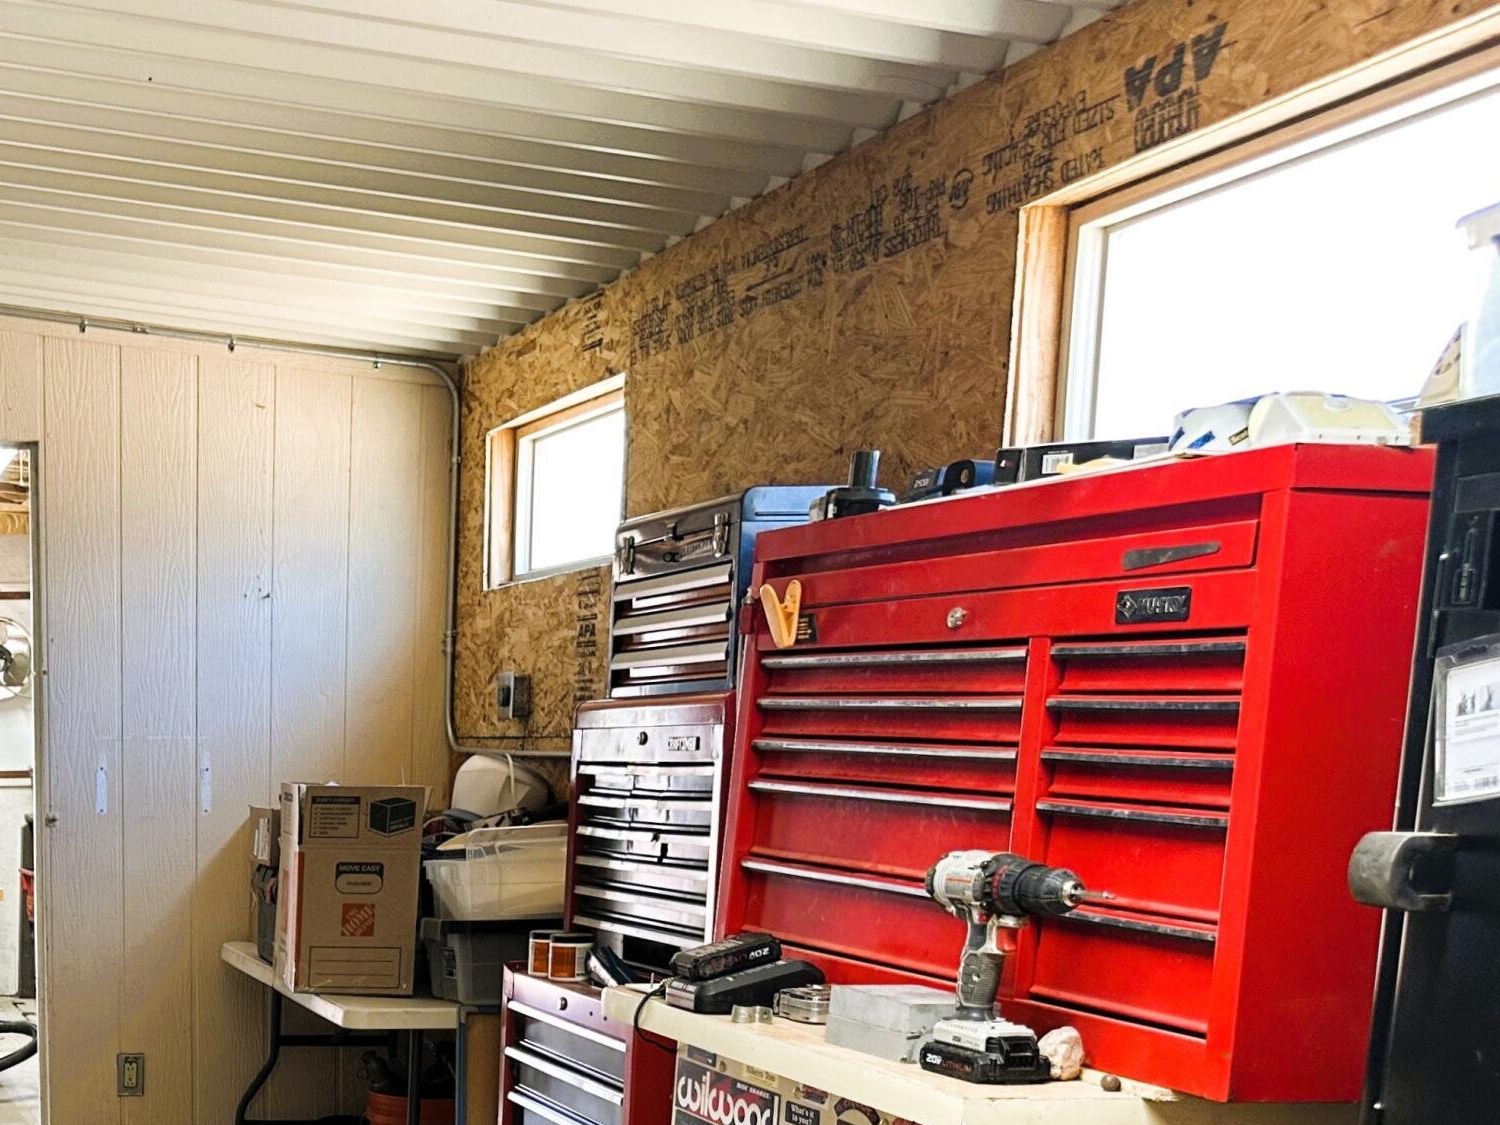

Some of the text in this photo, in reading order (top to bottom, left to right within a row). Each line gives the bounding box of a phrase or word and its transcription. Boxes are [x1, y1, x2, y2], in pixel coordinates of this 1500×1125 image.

[1124, 22, 1228, 111] APA
[1072, 99, 1116, 135] SIZED
[577, 624, 596, 640] APA
[339, 864, 381, 872] MOVE EASY
